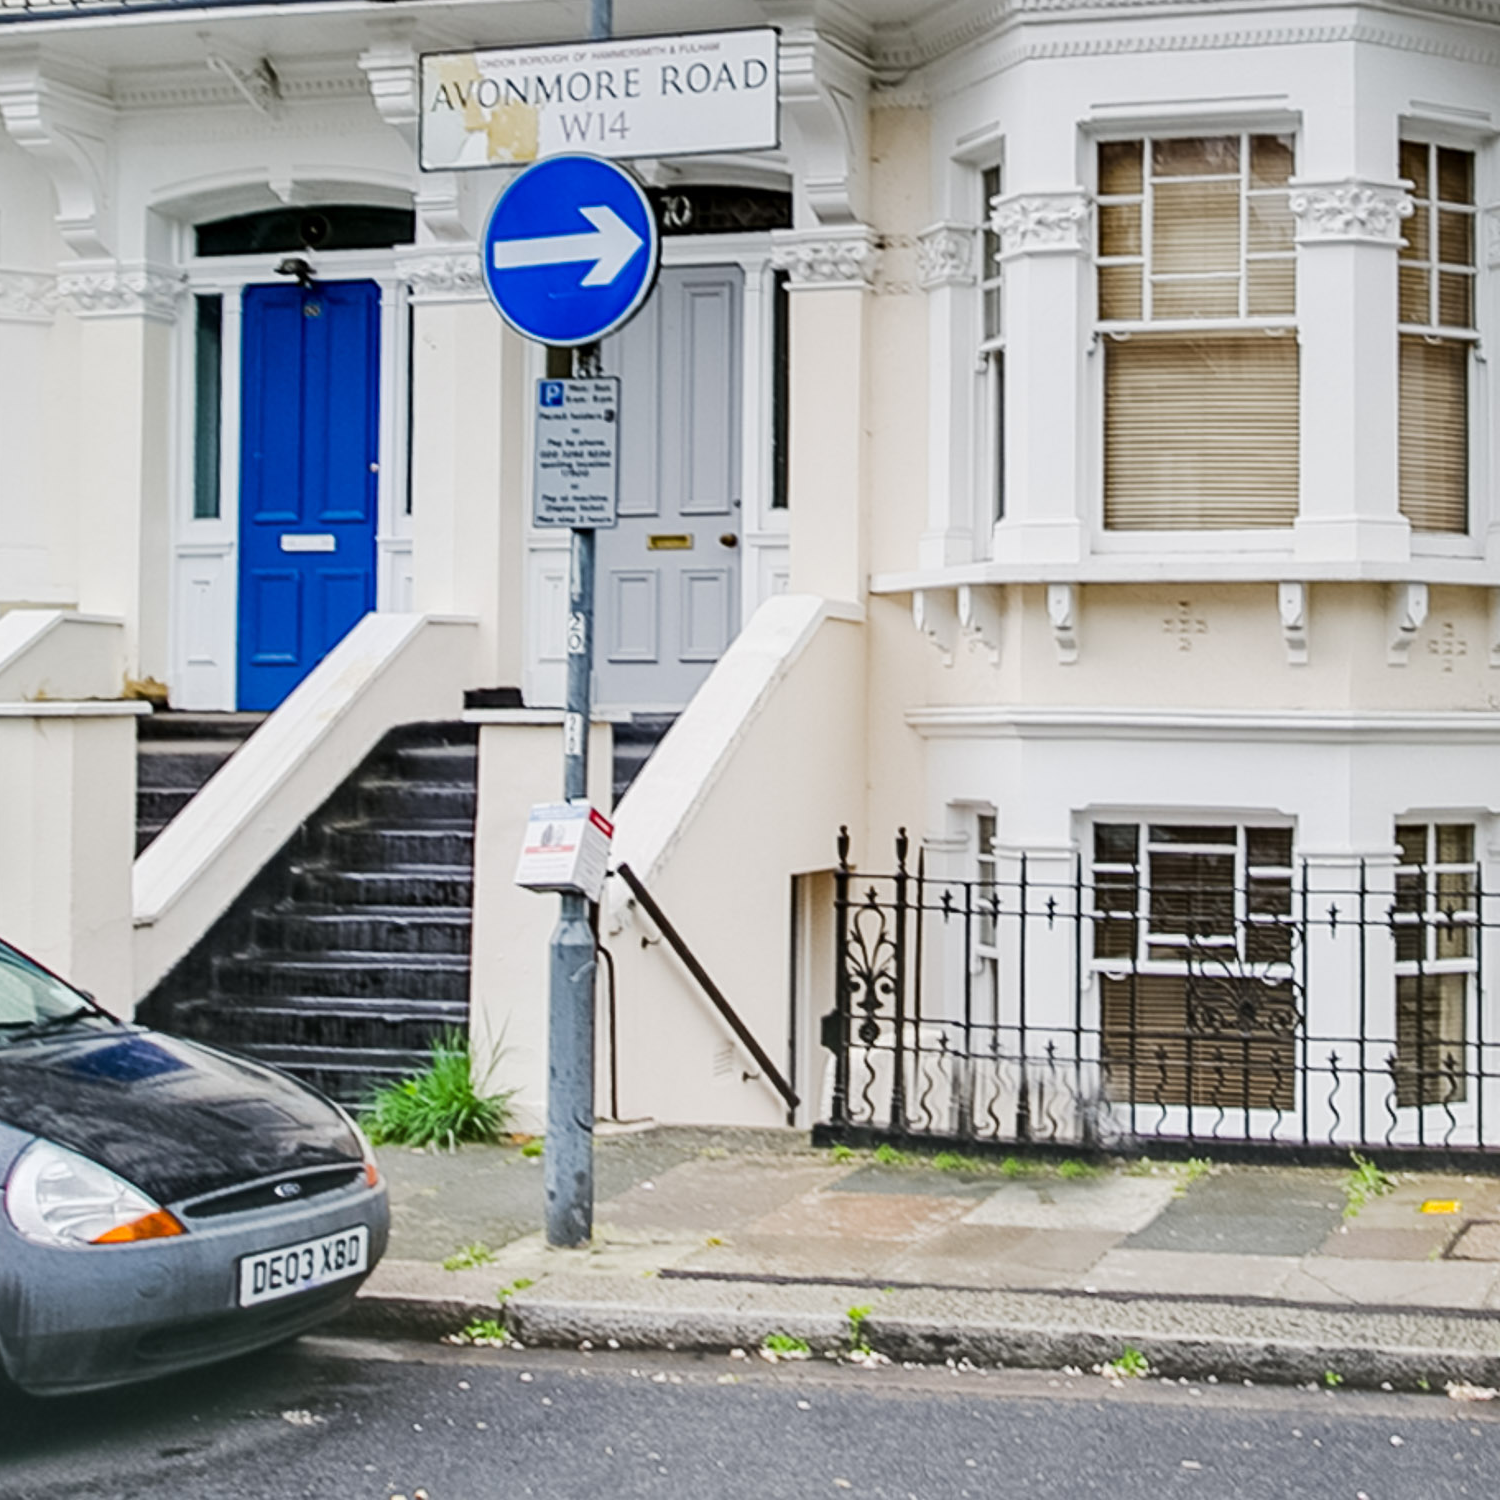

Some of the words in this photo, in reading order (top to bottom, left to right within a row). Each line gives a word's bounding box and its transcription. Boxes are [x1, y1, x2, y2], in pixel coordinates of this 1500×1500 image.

[430, 68, 641, 113] AVONMORE
[660, 58, 768, 96] ROAD
[559, 110, 631, 143] W14
[660, 196, 692, 227] 70
[546, 384, 561, 404] P
[320, 1234, 360, 1275] XBD
